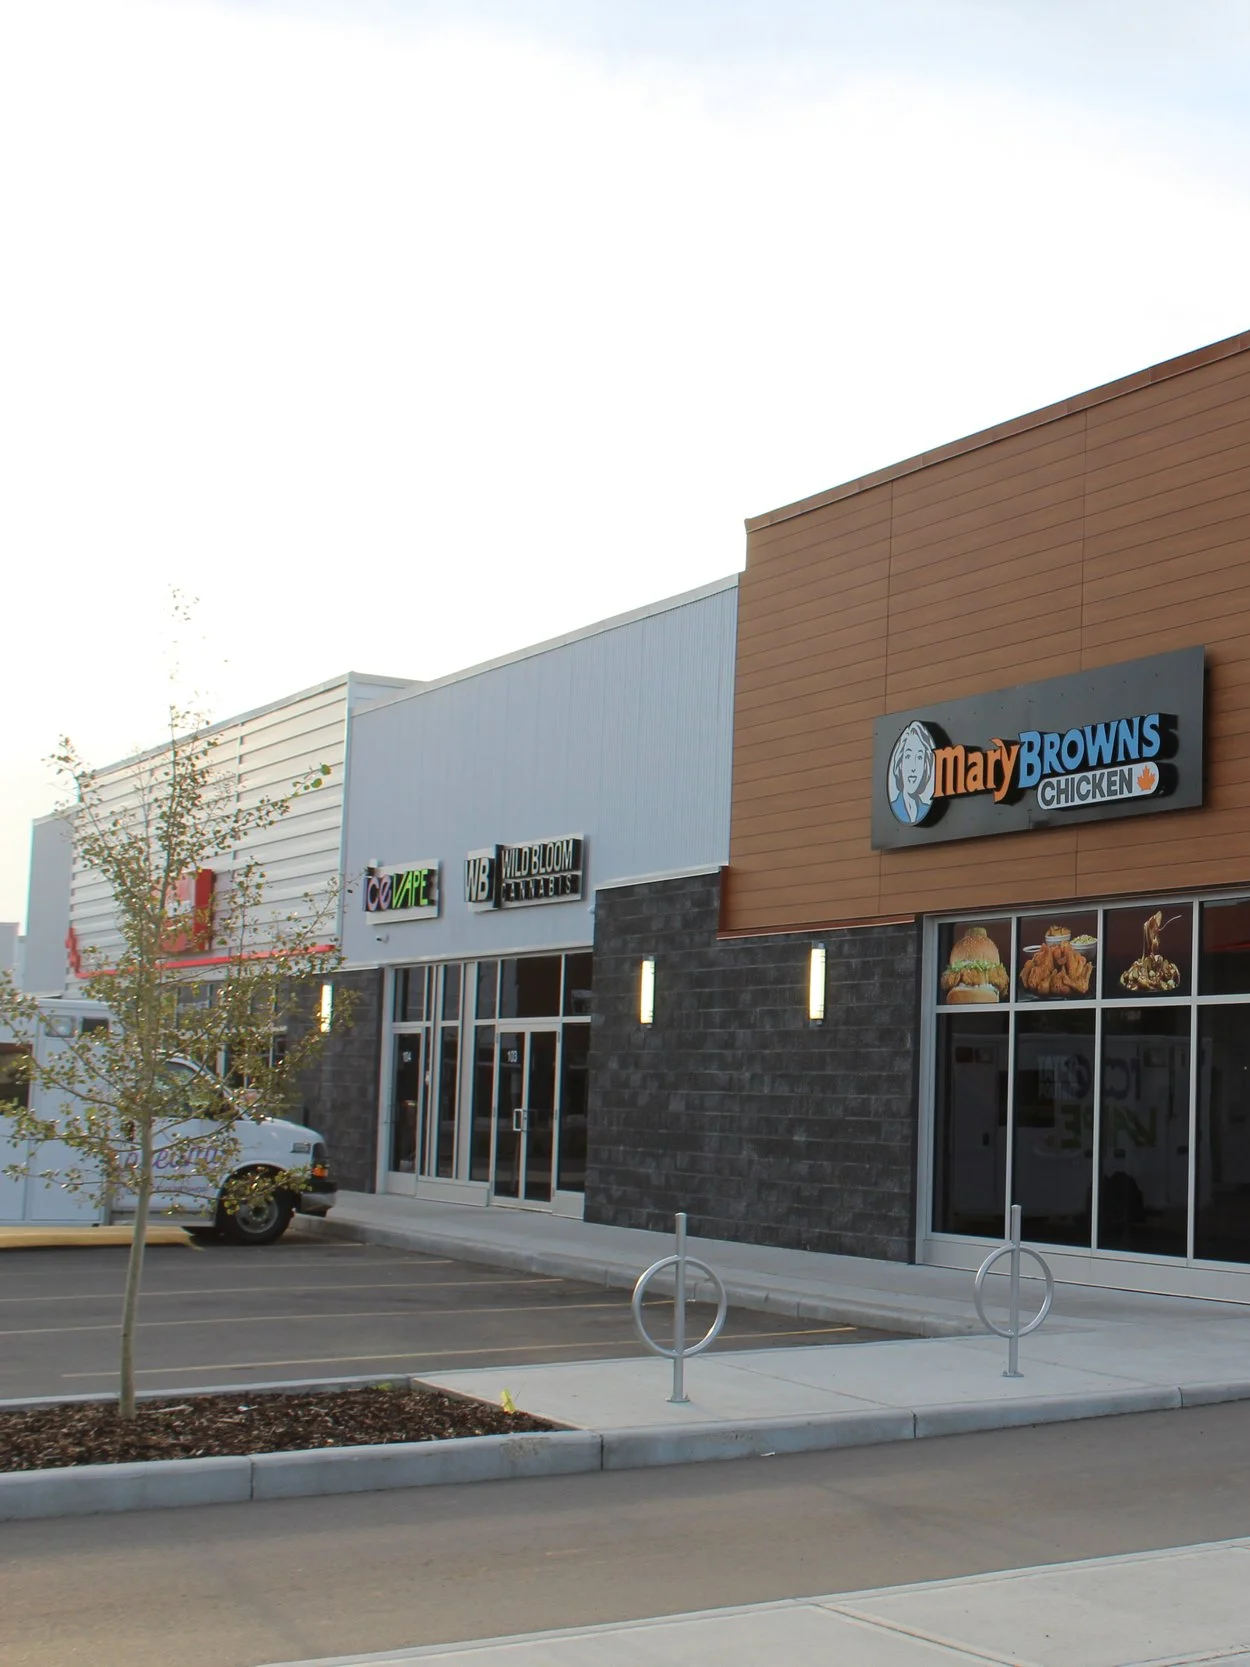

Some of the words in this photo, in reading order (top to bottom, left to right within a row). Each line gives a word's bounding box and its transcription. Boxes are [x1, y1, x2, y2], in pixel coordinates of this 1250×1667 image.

[934, 737, 1020, 802] mary
[1017, 713, 1161, 788] BROWNS
[1040, 768, 1133, 806] CHICKEN
[502, 847, 529, 879] WILD
[531, 839, 573, 875] BLOOM
[464, 857, 490, 902] WB
[502, 874, 571, 902] CANNABIS
